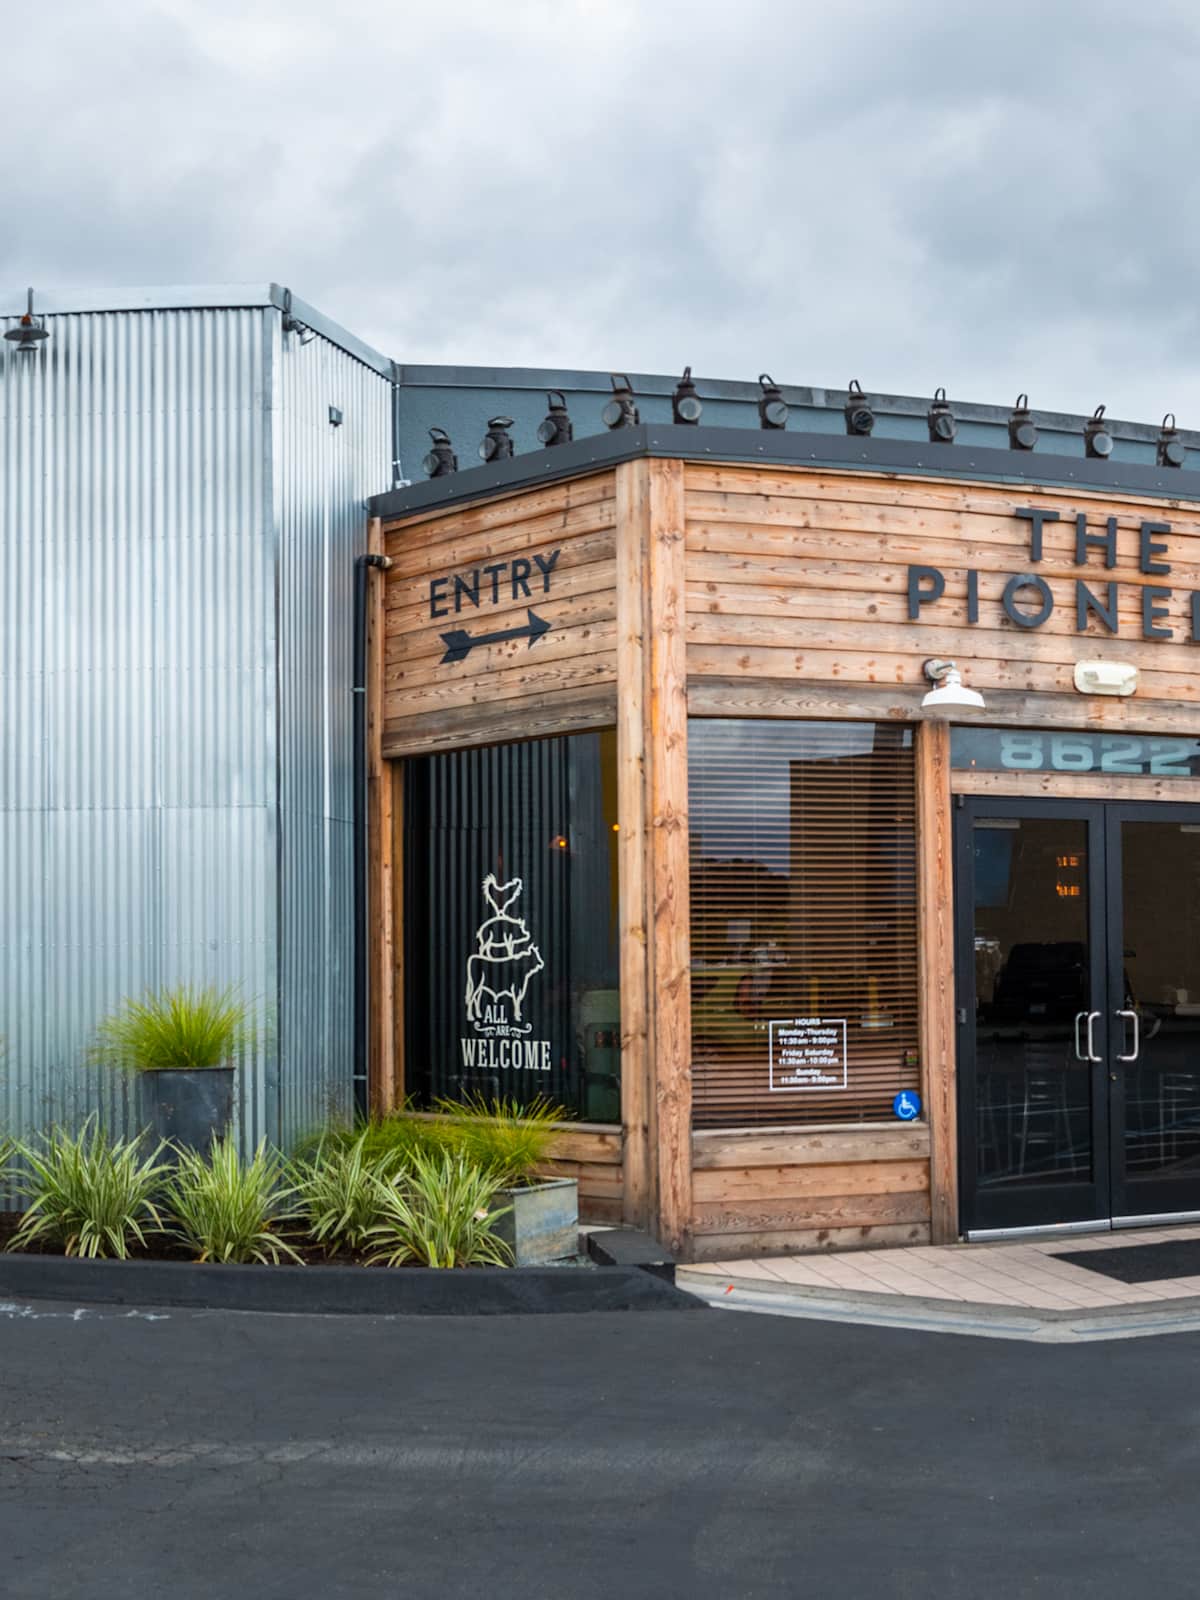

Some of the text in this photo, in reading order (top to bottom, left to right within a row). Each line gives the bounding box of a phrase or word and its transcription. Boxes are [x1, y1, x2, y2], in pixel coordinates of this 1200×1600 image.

[1016, 507, 1172, 575] THE
[430, 549, 561, 619] ENTRY
[1000, 734, 1191, 776] 8622
[484, 1004, 508, 1024] ALL
[495, 1025, 510, 1036] ARE
[461, 1038, 552, 1070] WELCOME
[782, 1049, 803, 1057] Friday
